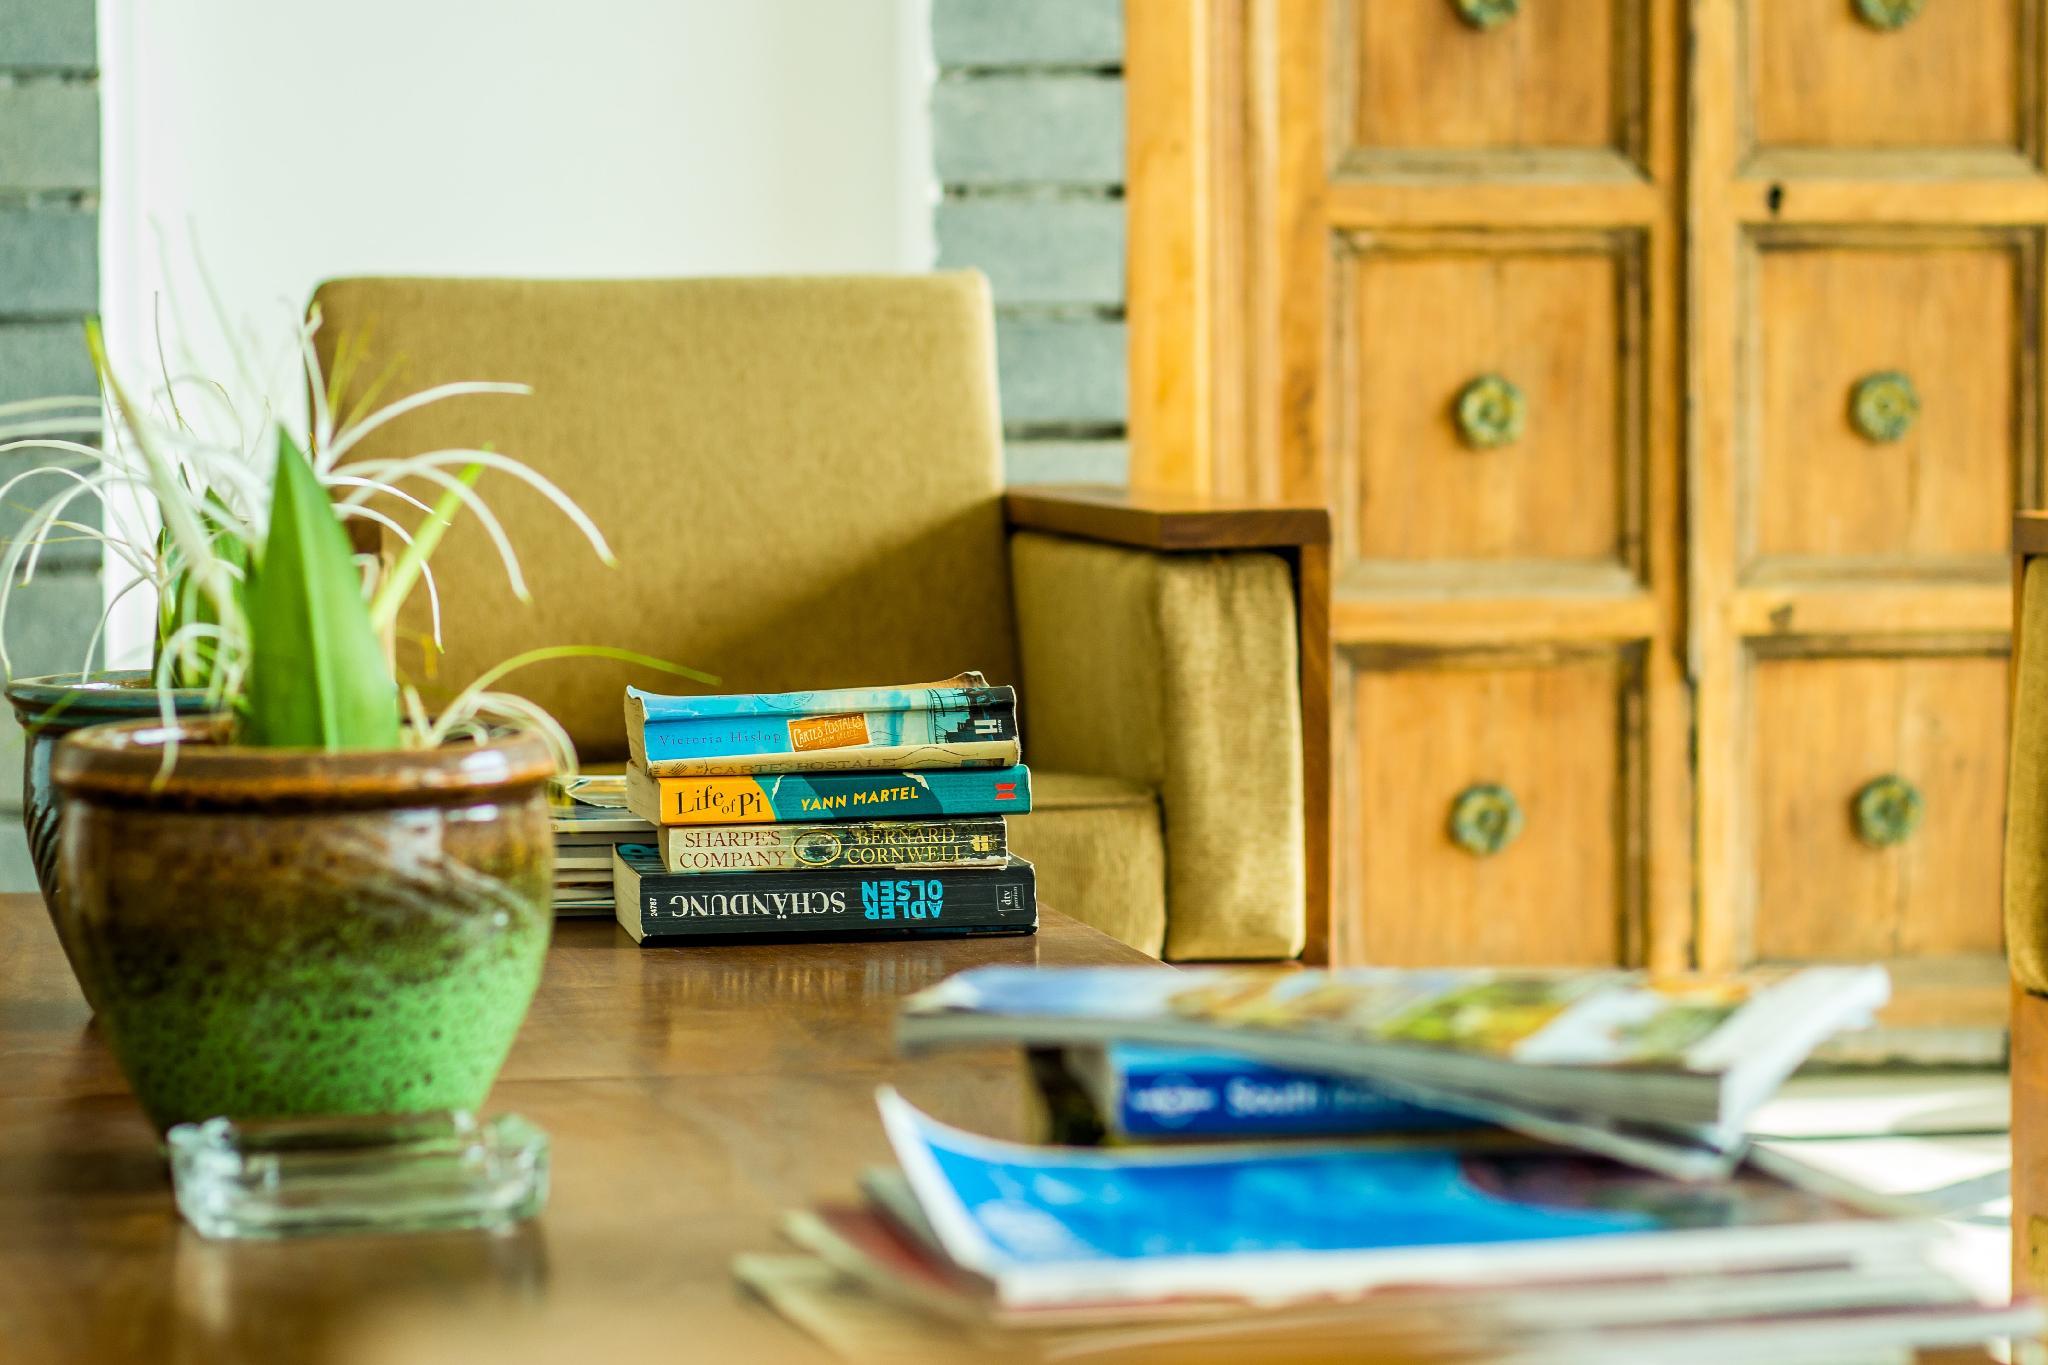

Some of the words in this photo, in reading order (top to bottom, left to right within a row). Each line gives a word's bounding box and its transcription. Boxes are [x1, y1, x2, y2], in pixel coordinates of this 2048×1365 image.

[658, 734, 723, 747] Victoria
[729, 730, 782, 744] Hislop
[674, 785, 724, 816] Life
[721, 798, 736, 815] of
[737, 791, 763, 818] Pi
[801, 794, 847, 812] YANN
[853, 786, 919, 806] MARTEL
[685, 830, 781, 848] SHARPE'S
[857, 827, 956, 846] BERNARD
[679, 850, 786, 869] COMPANY
[847, 845, 966, 864] CORNWELL
[861, 879, 944, 901] OLSEN
[1000, 890, 1011, 905] dtv
[669, 890, 846, 919] SCHÄNDUNG
[863, 899, 944, 920] ADLER
